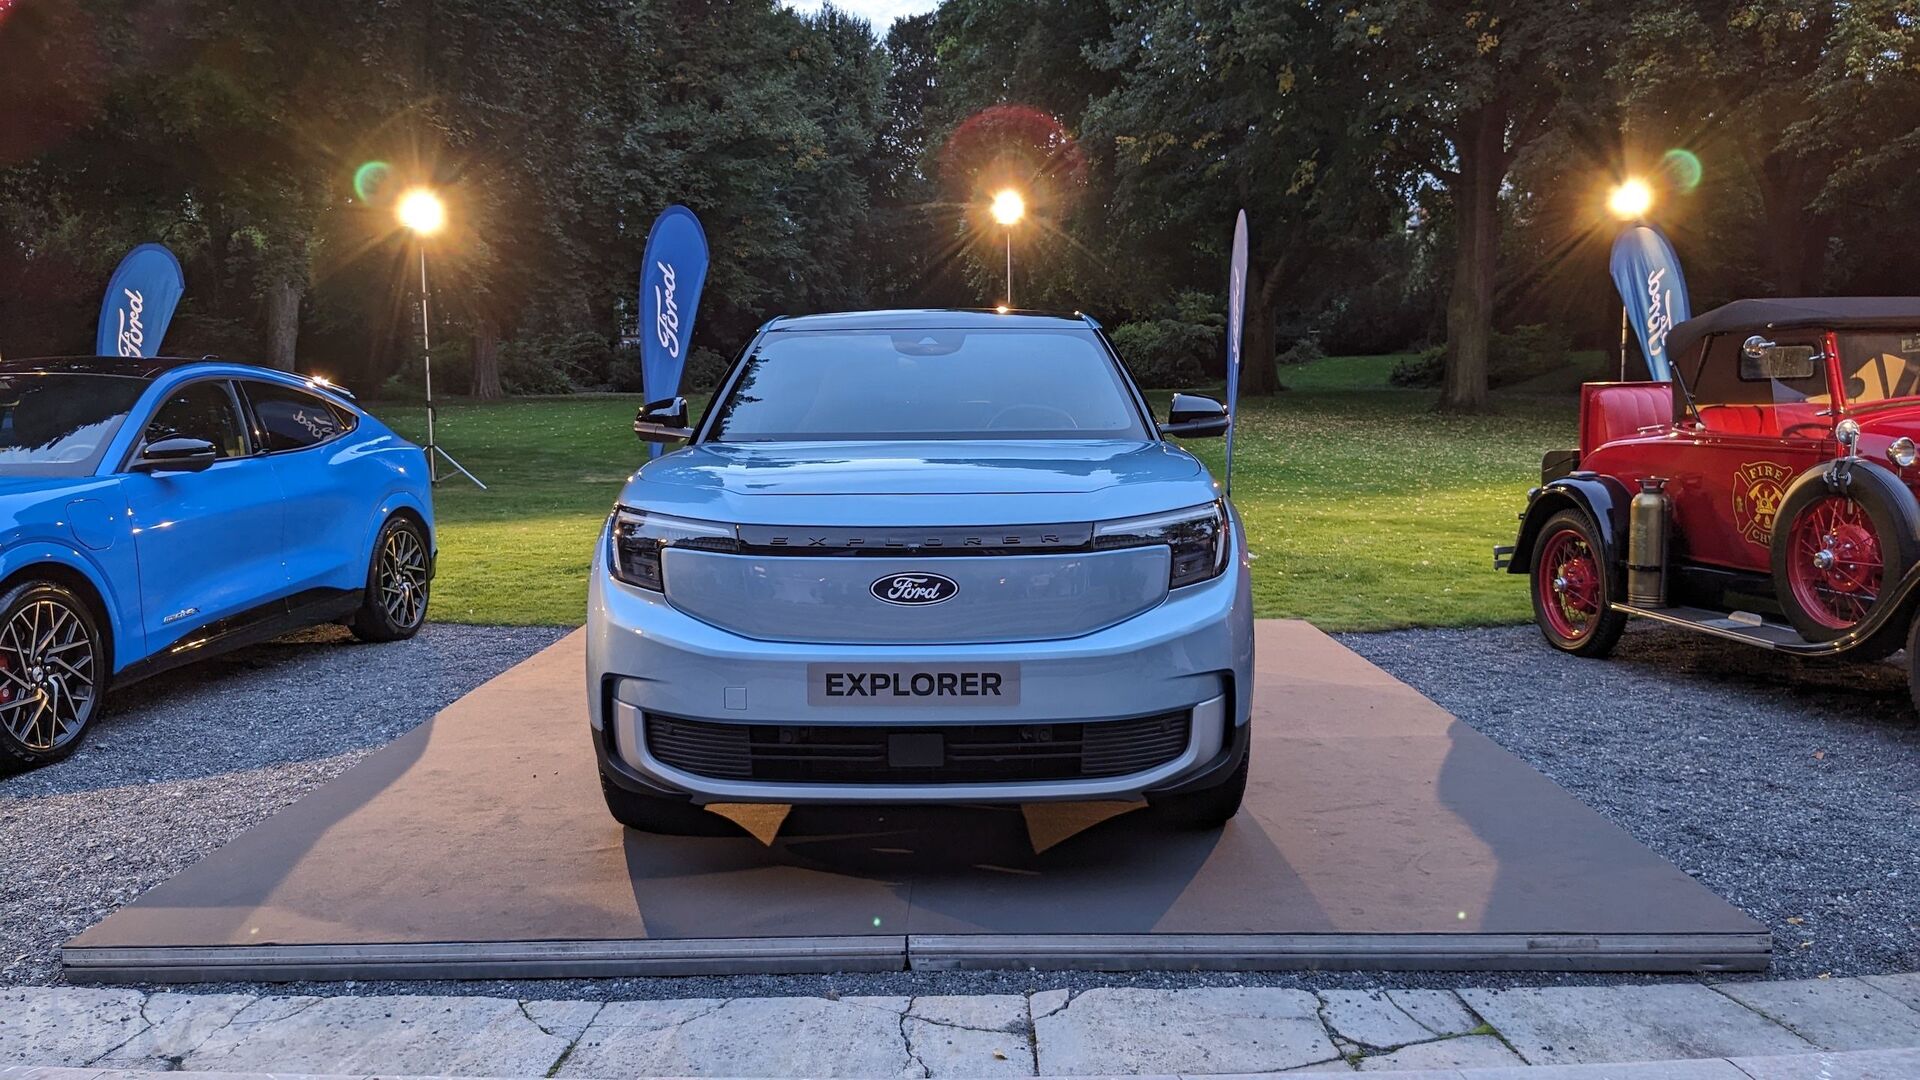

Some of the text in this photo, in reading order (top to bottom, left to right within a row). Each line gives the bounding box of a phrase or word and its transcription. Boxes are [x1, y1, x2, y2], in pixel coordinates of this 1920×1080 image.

[656, 261, 679, 358] Ford
[118, 288, 143, 357] Ford
[1749, 465, 1783, 480] FIRE
[770, 534, 1060, 547] EXPLORER
[887, 576, 941, 600] Ford
[825, 672, 1002, 697] EXPLORER
